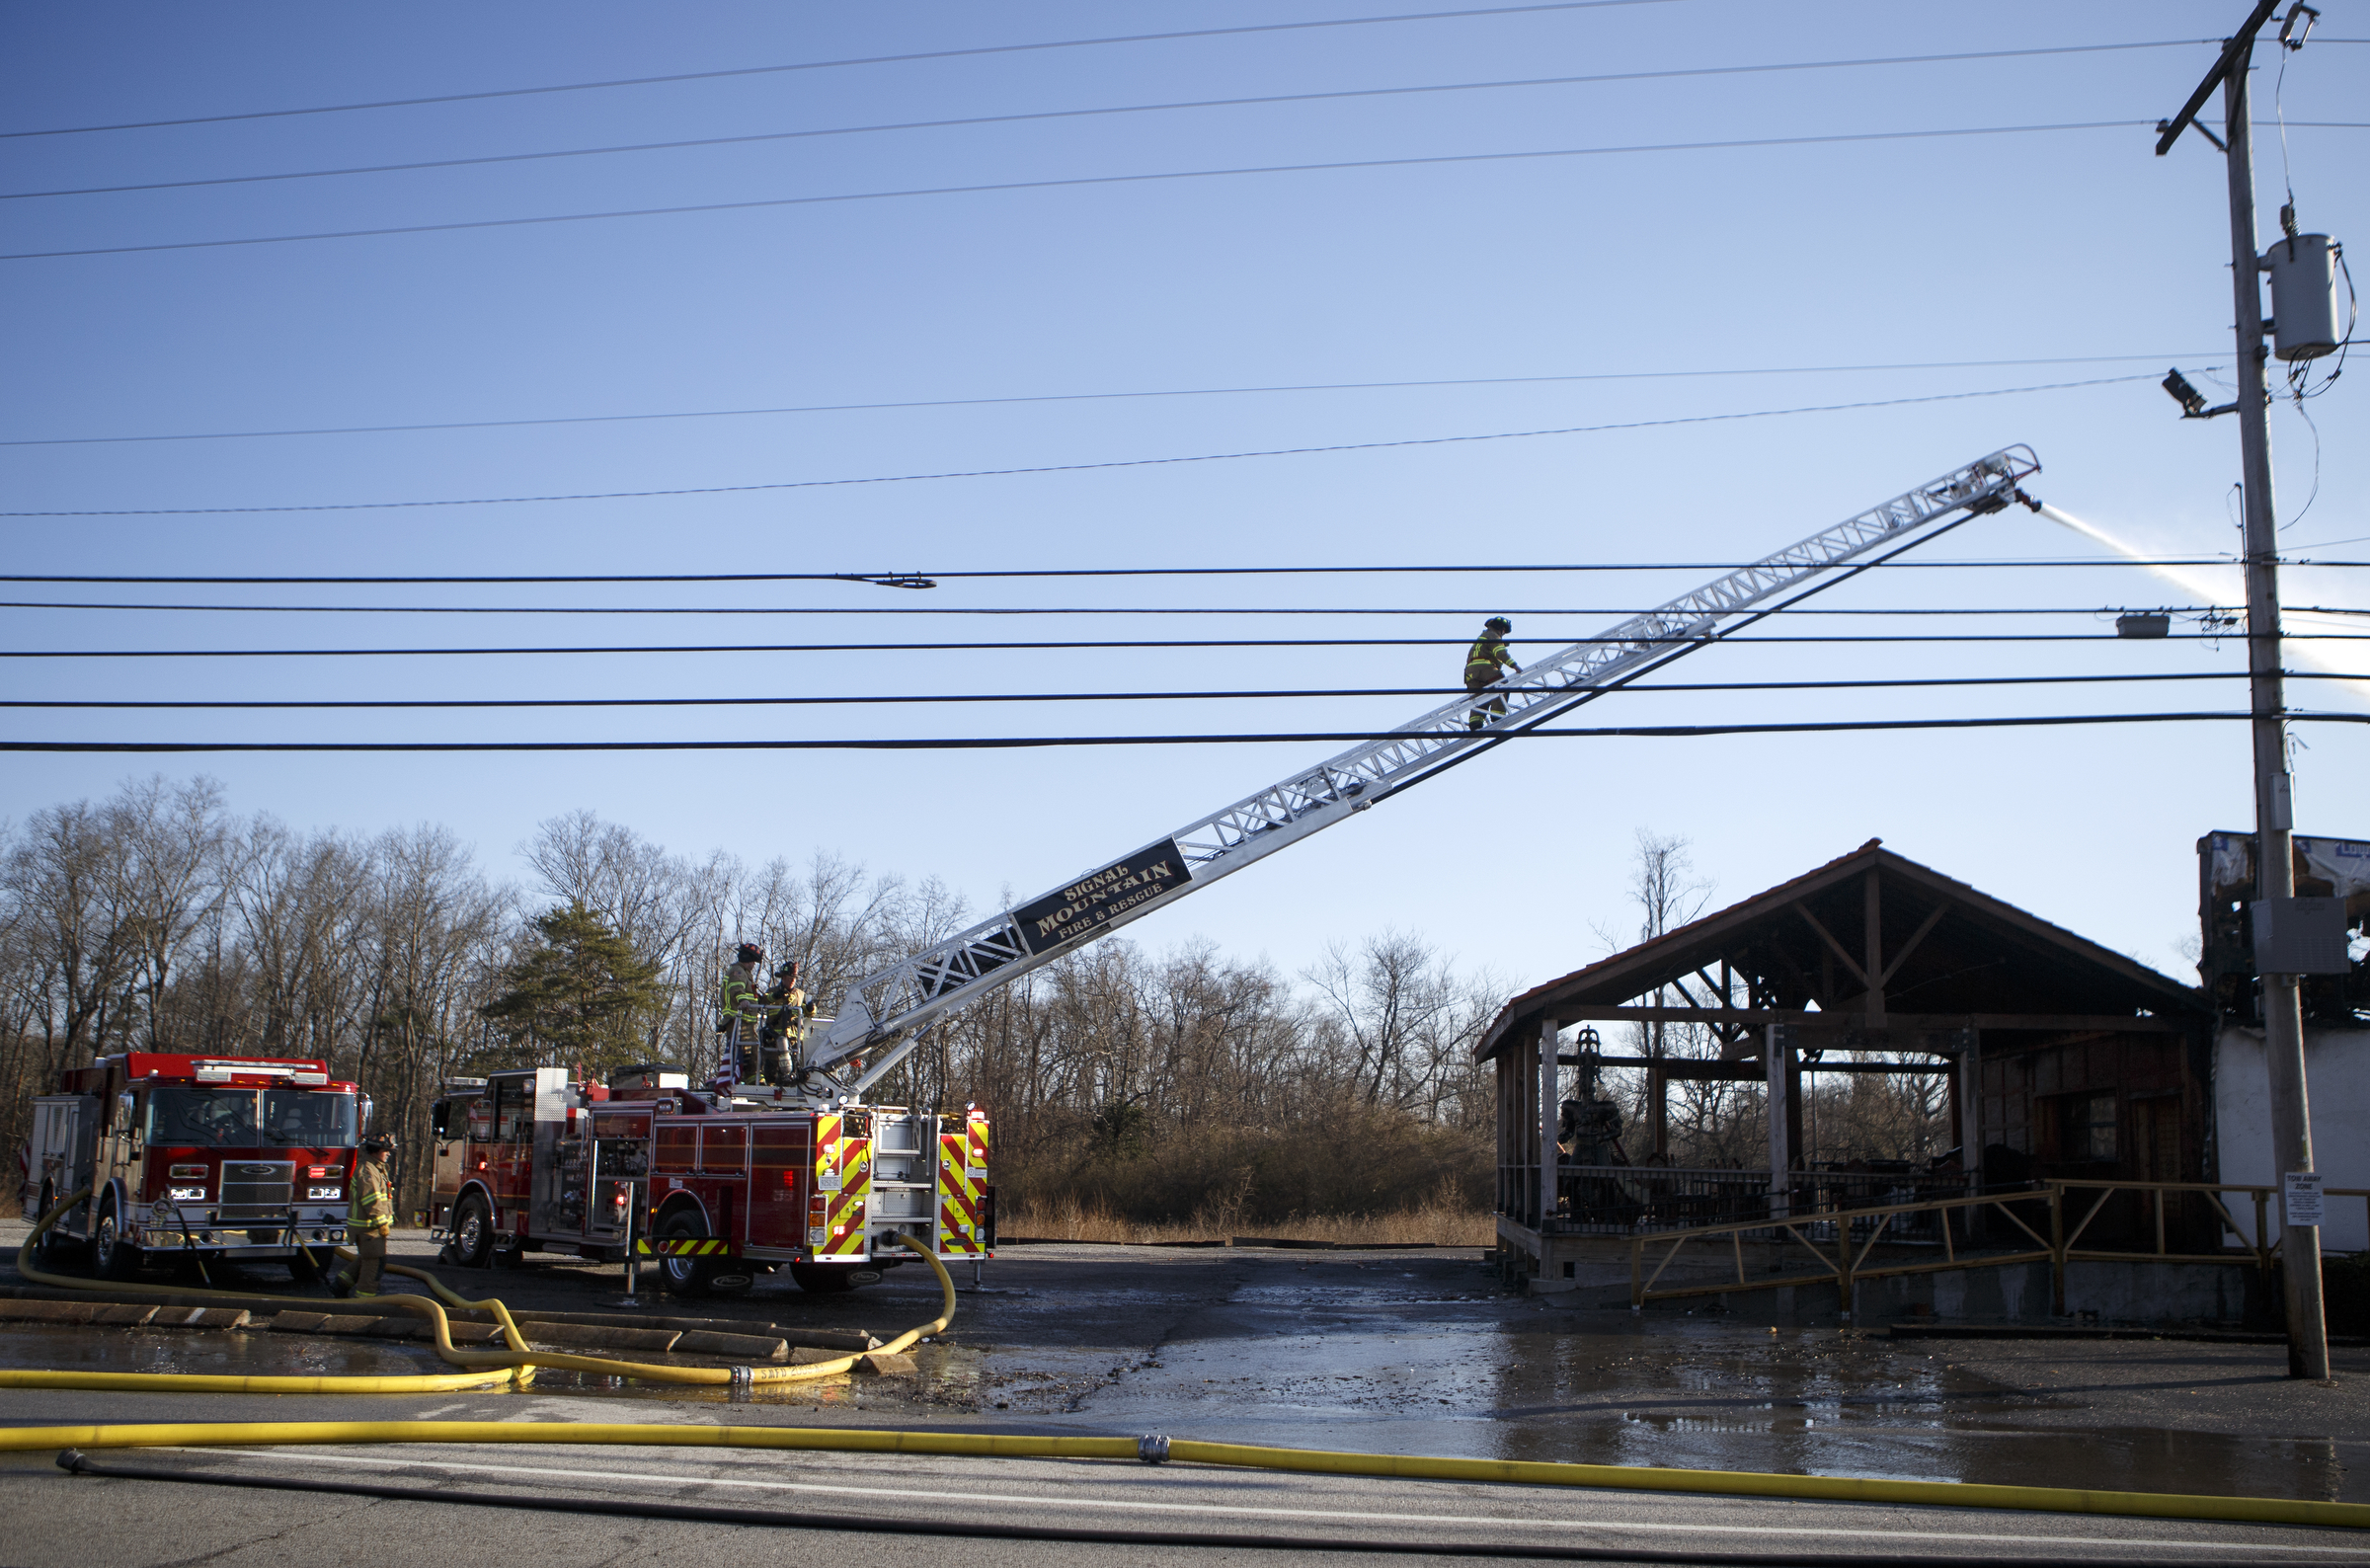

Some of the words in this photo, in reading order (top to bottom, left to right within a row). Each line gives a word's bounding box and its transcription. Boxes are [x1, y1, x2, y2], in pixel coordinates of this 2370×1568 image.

[1036, 860, 1174, 938] MOUNTAIN
[1064, 865, 1130, 902] SIGNAL
[1058, 916, 1092, 940] FIRE
[1095, 908, 1106, 921] &
[1109, 883, 1163, 915] RESCUE
[760, 1368, 787, 1379] SMFD
